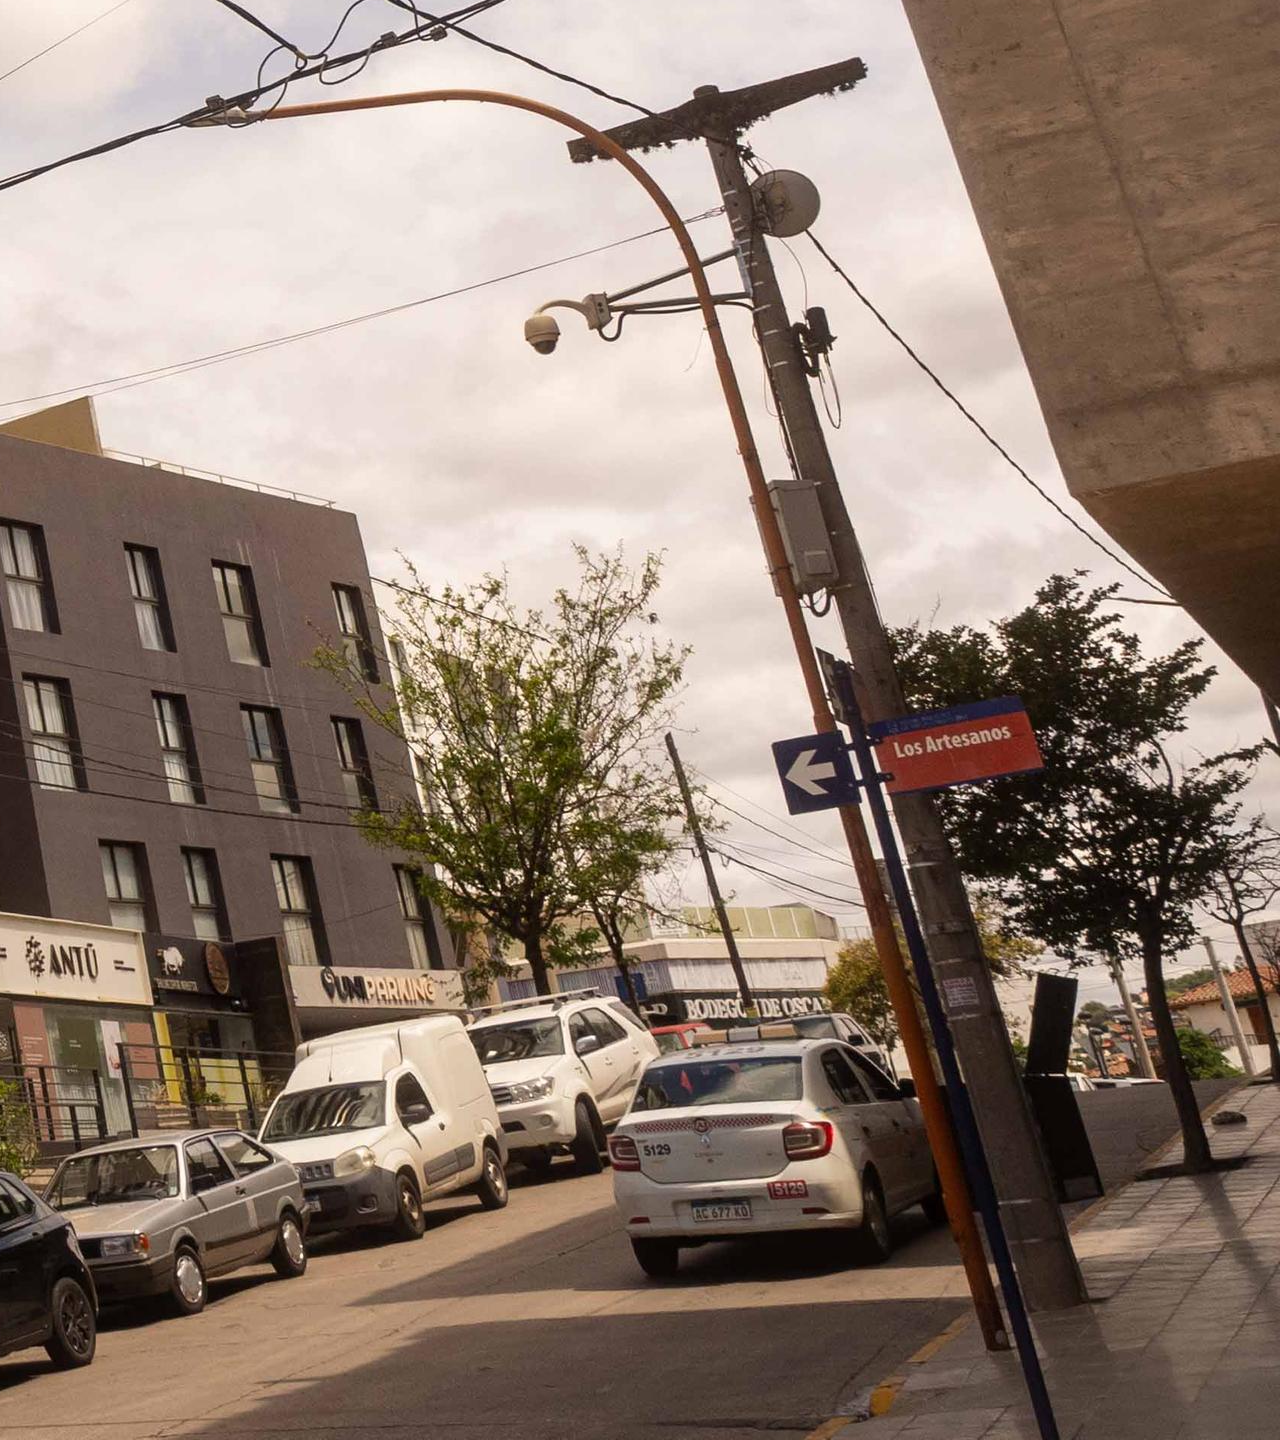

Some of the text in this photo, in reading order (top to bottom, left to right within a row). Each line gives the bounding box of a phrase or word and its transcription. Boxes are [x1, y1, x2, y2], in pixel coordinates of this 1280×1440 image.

[894, 725, 1012, 758] Los Artesanos
[335, 974, 436, 1003] UNIPARKING
[759, 998, 783, 1017] DE
[643, 1144, 671, 1157] 5129
[774, 1181, 806, 1196] 5129
[711, 1206, 730, 1218] 677
